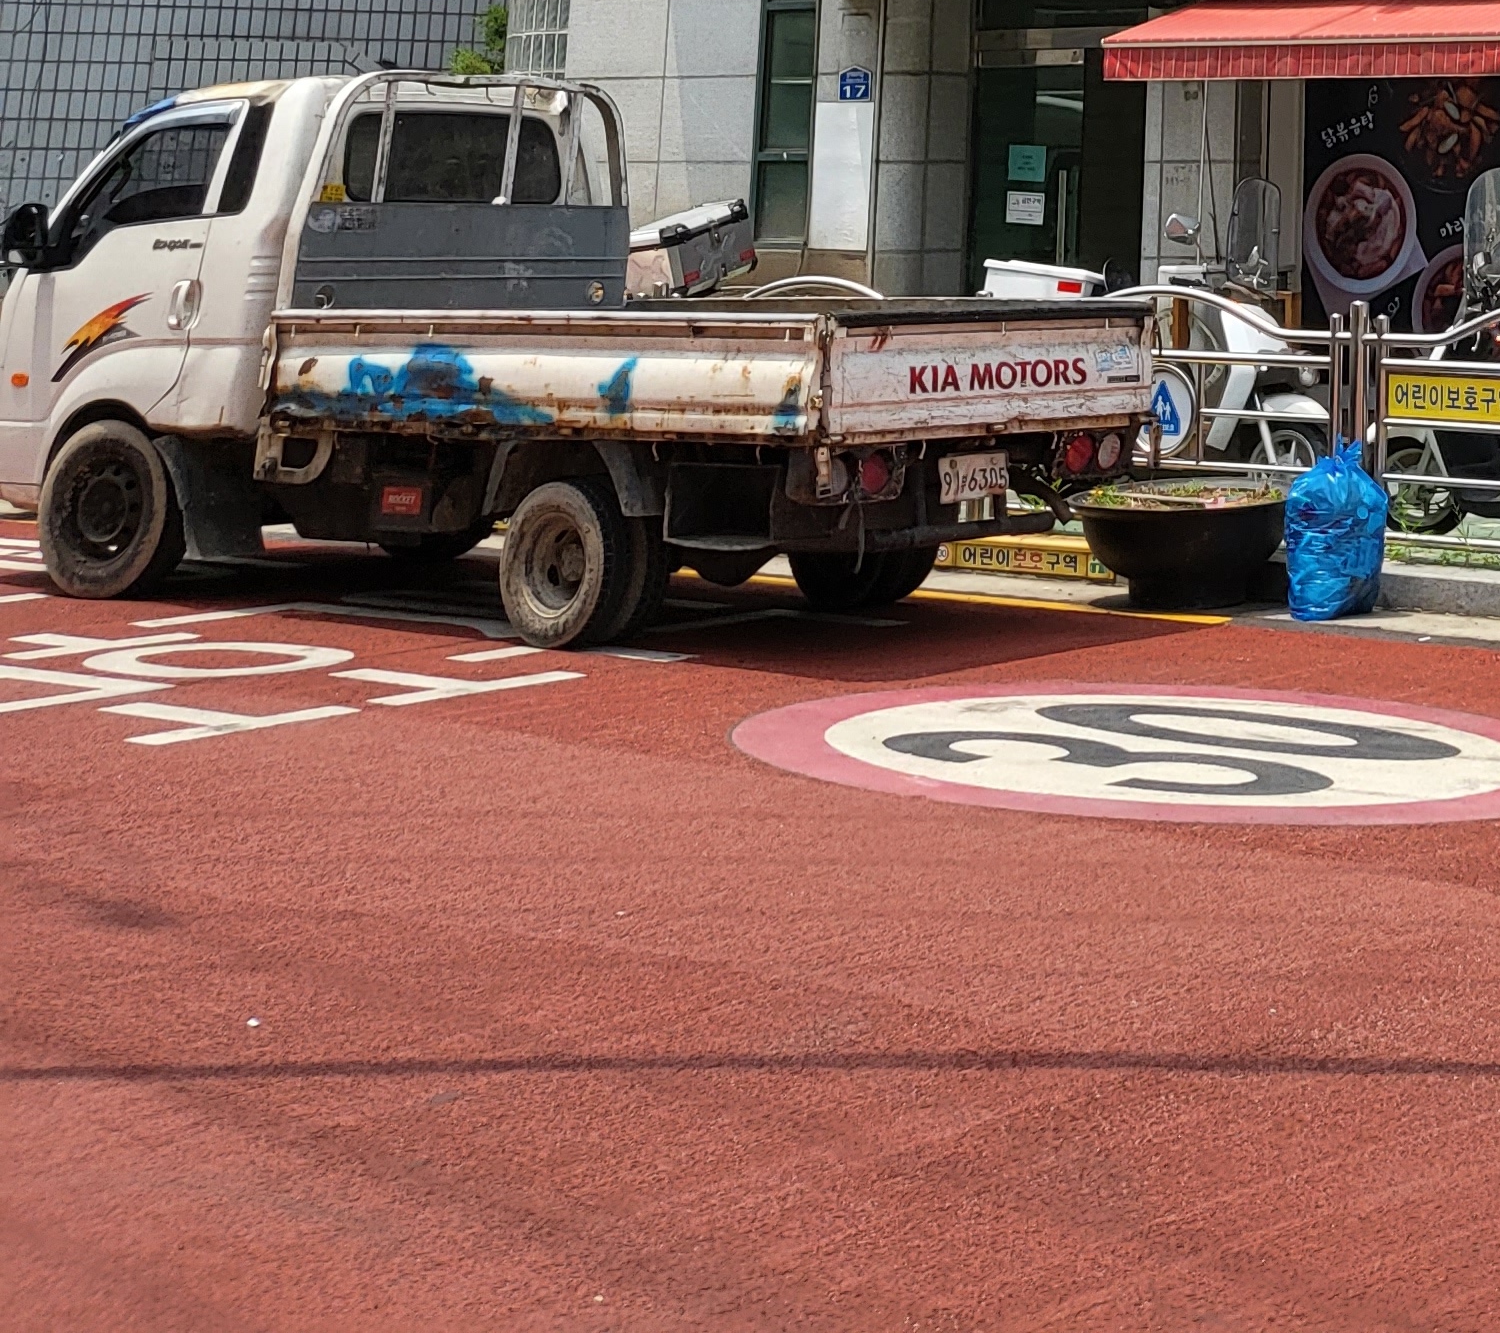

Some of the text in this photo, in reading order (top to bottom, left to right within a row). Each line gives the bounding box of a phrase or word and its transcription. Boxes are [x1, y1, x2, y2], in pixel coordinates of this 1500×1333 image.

[843, 84, 866, 99] 17
[909, 358, 1087, 394] KIA MOTORS
[962, 546, 1078, 573] 어린이보호구역
[880, 702, 1463, 797] 30
